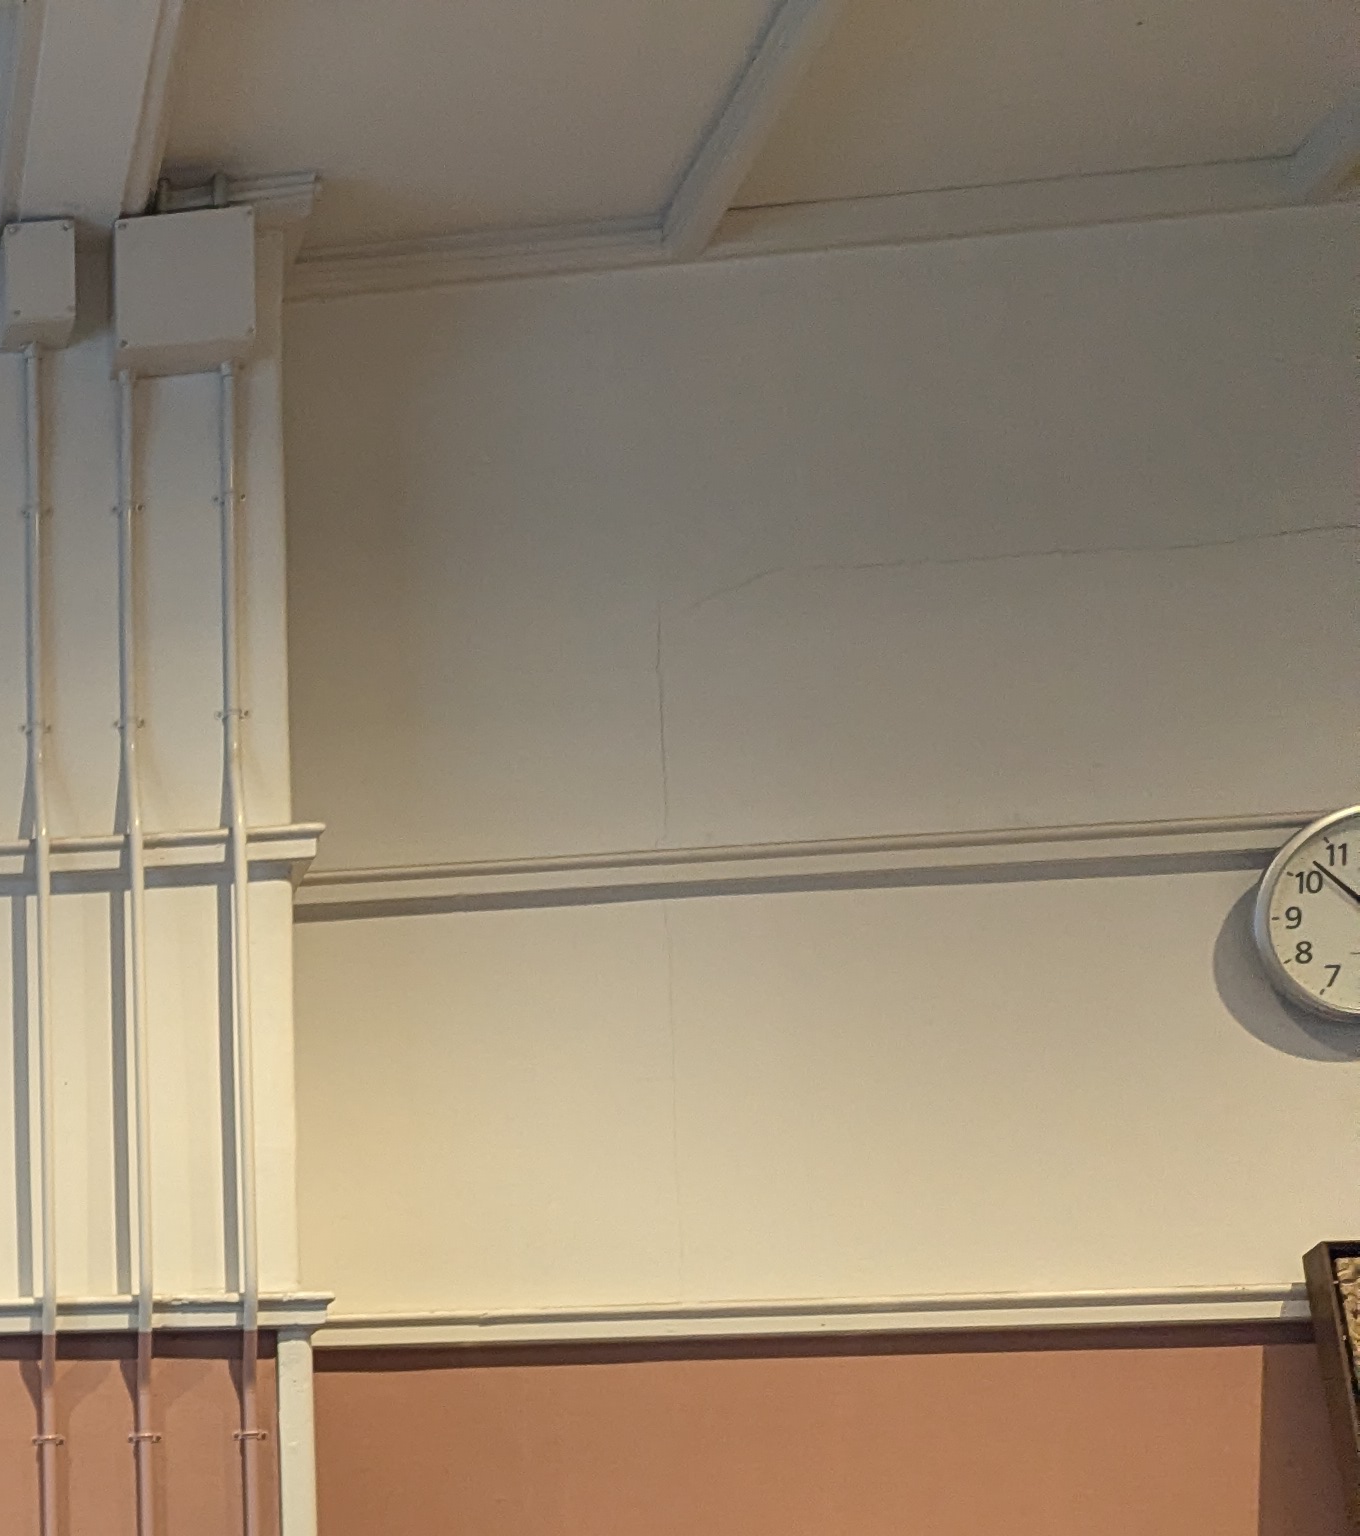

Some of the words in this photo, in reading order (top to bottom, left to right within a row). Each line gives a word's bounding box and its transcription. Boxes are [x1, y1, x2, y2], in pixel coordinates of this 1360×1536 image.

[1325, 843, 1348, 867] 11
[1295, 870, 1324, 894] 10
[1285, 906, 1303, 930] 9
[1295, 941, 1313, 964] 8
[1324, 964, 1341, 988] 7
